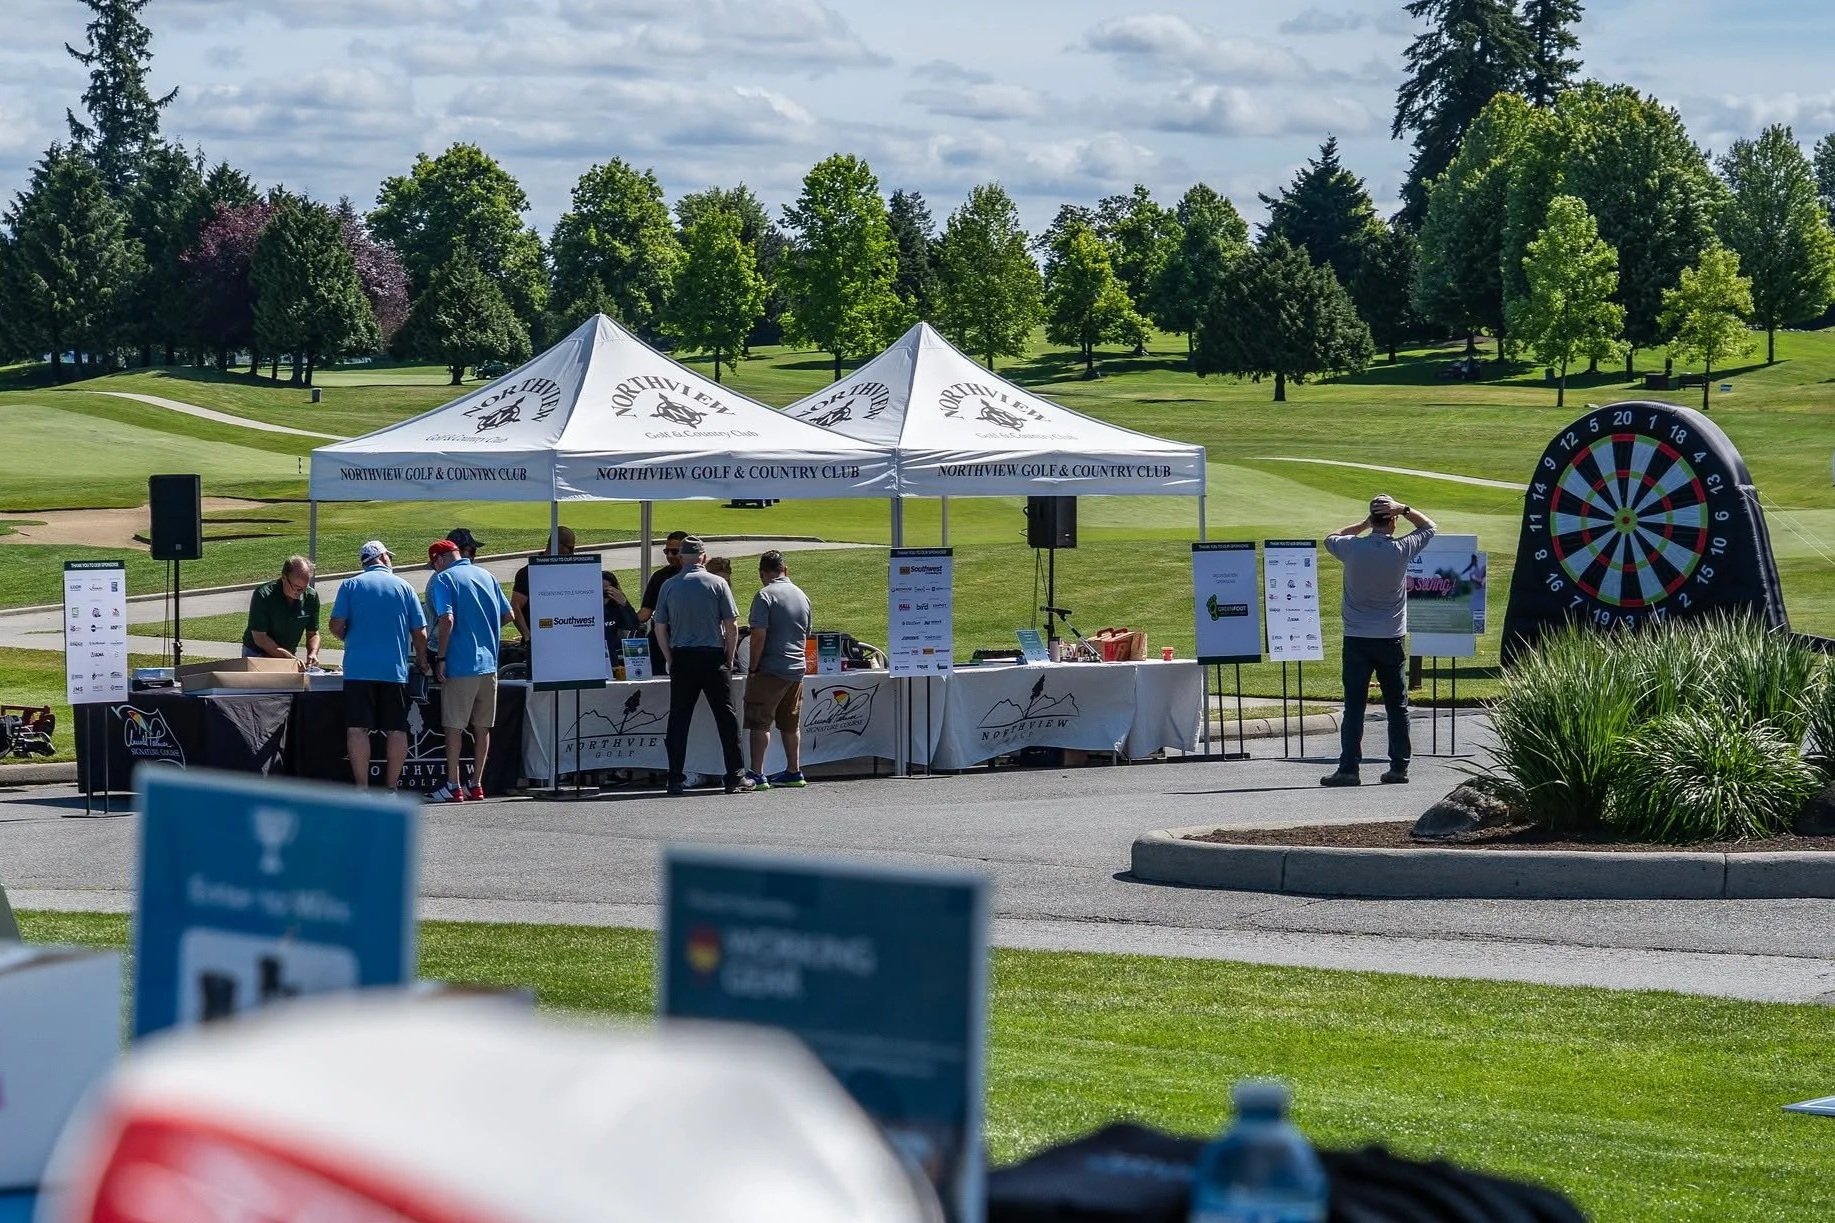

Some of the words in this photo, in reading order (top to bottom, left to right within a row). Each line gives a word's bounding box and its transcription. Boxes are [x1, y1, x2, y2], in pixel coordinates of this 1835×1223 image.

[462, 377, 561, 423] NORTHVIEW
[611, 375, 736, 418] NORTHVIEW
[939, 382, 1051, 422] NORTHVIEW
[1589, 418, 1599, 433] 5
[1613, 410, 1633, 426] 20
[1648, 414, 1658, 429] 1
[645, 430, 670, 440] Golf
[671, 430, 683, 438] &
[683, 430, 731, 440] Country
[731, 429, 760, 438] Club
[1559, 430, 1579, 451] 12
[1670, 424, 1687, 445] 18
[1544, 456, 1557, 471] 9
[1693, 451, 1707, 463] 4
[340, 467, 404, 481] NORTHVIEW
[405, 467, 434, 481] GOLF
[435, 467, 444, 481] &
[447, 467, 498, 481] COUNTRY
[498, 468, 527, 481] CLUB
[597, 467, 688, 481] NORTHVIEW
[691, 465, 731, 479] GOLF
[734, 466, 745, 479] &
[749, 465, 818, 479] COUNTRY
[821, 465, 860, 478] CLUB
[938, 464, 1019, 478] NORTHVIEW
[1021, 464, 1055, 477] GOLF
[1059, 464, 1069, 477] &
[1072, 464, 1134, 478] COUNTRY
[1136, 465, 1171, 478] CLUB
[1532, 482, 1548, 501] 14
[1706, 473, 1724, 495] 13
[1529, 513, 1542, 533] 11
[1715, 510, 1729, 522] 6
[1535, 548, 1548, 561] 8
[1711, 537, 1728, 556] 10
[911, 565, 942, 573] Southwest
[1696, 564, 1715, 585] 15
[1545, 572, 1564, 593] 16
[1569, 595, 1583, 609] 7
[1679, 593, 1692, 609] 2
[553, 616, 595, 625] Southwest
[1593, 608, 1611, 626] 19
[981, 719, 1069, 741] NORTHVIEW
[565, 737, 668, 753] NORTHVIE
[595, 750, 635, 759] GOLF
[396, 778, 438, 787] GOLF
